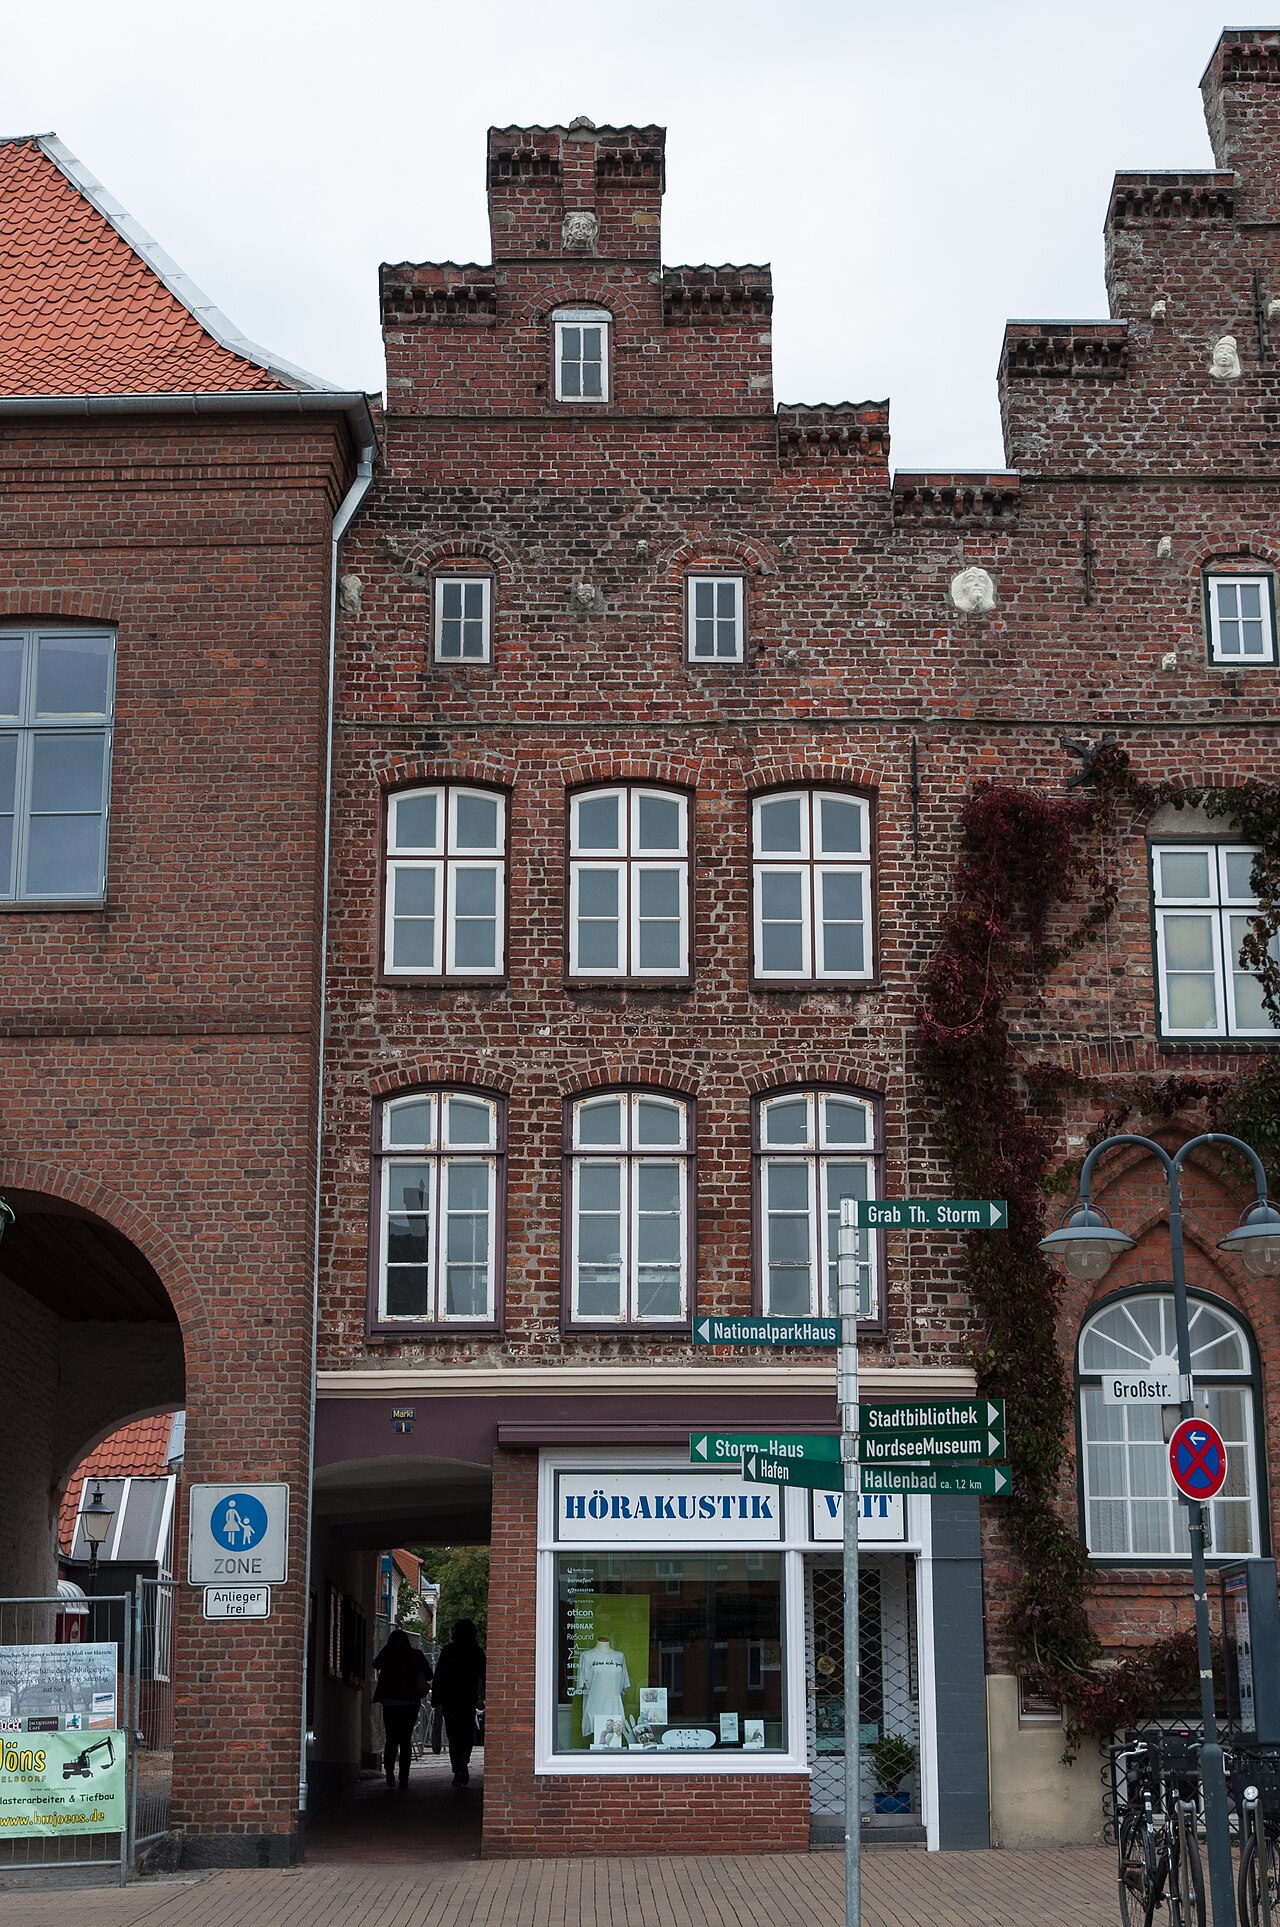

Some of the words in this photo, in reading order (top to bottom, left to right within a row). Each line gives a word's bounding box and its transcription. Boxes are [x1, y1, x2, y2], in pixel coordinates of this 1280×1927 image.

[868, 1206, 901, 1224] Grab
[908, 1206, 930, 1223] Th.
[937, 1206, 981, 1224] Storm
[714, 1322, 837, 1345] NationalparkHaus
[1113, 1380, 1171, 1398] Großstr.
[393, 1410, 414, 1418] Markt
[868, 1406, 978, 1428] Stadtbibliothek
[401, 1422, 406, 1433] 1
[715, 1439, 805, 1458] Storm-Haus
[866, 1437, 981, 1457] NordseeMuseum
[760, 1459, 790, 1480] Hafen
[864, 1470, 937, 1489] Hallenbad
[940, 1481, 952, 1489] ca.
[969, 1479, 982, 1490] km
[565, 1489, 774, 1519] HÖRAKUSTIK
[824, 1494, 893, 1518] VIT
[213, 1558, 262, 1574] ZONE
[213, 1591, 262, 1604] Anlieger
[226, 1603, 246, 1614] frei
[80, 1793, 115, 1802] Tiefbau
